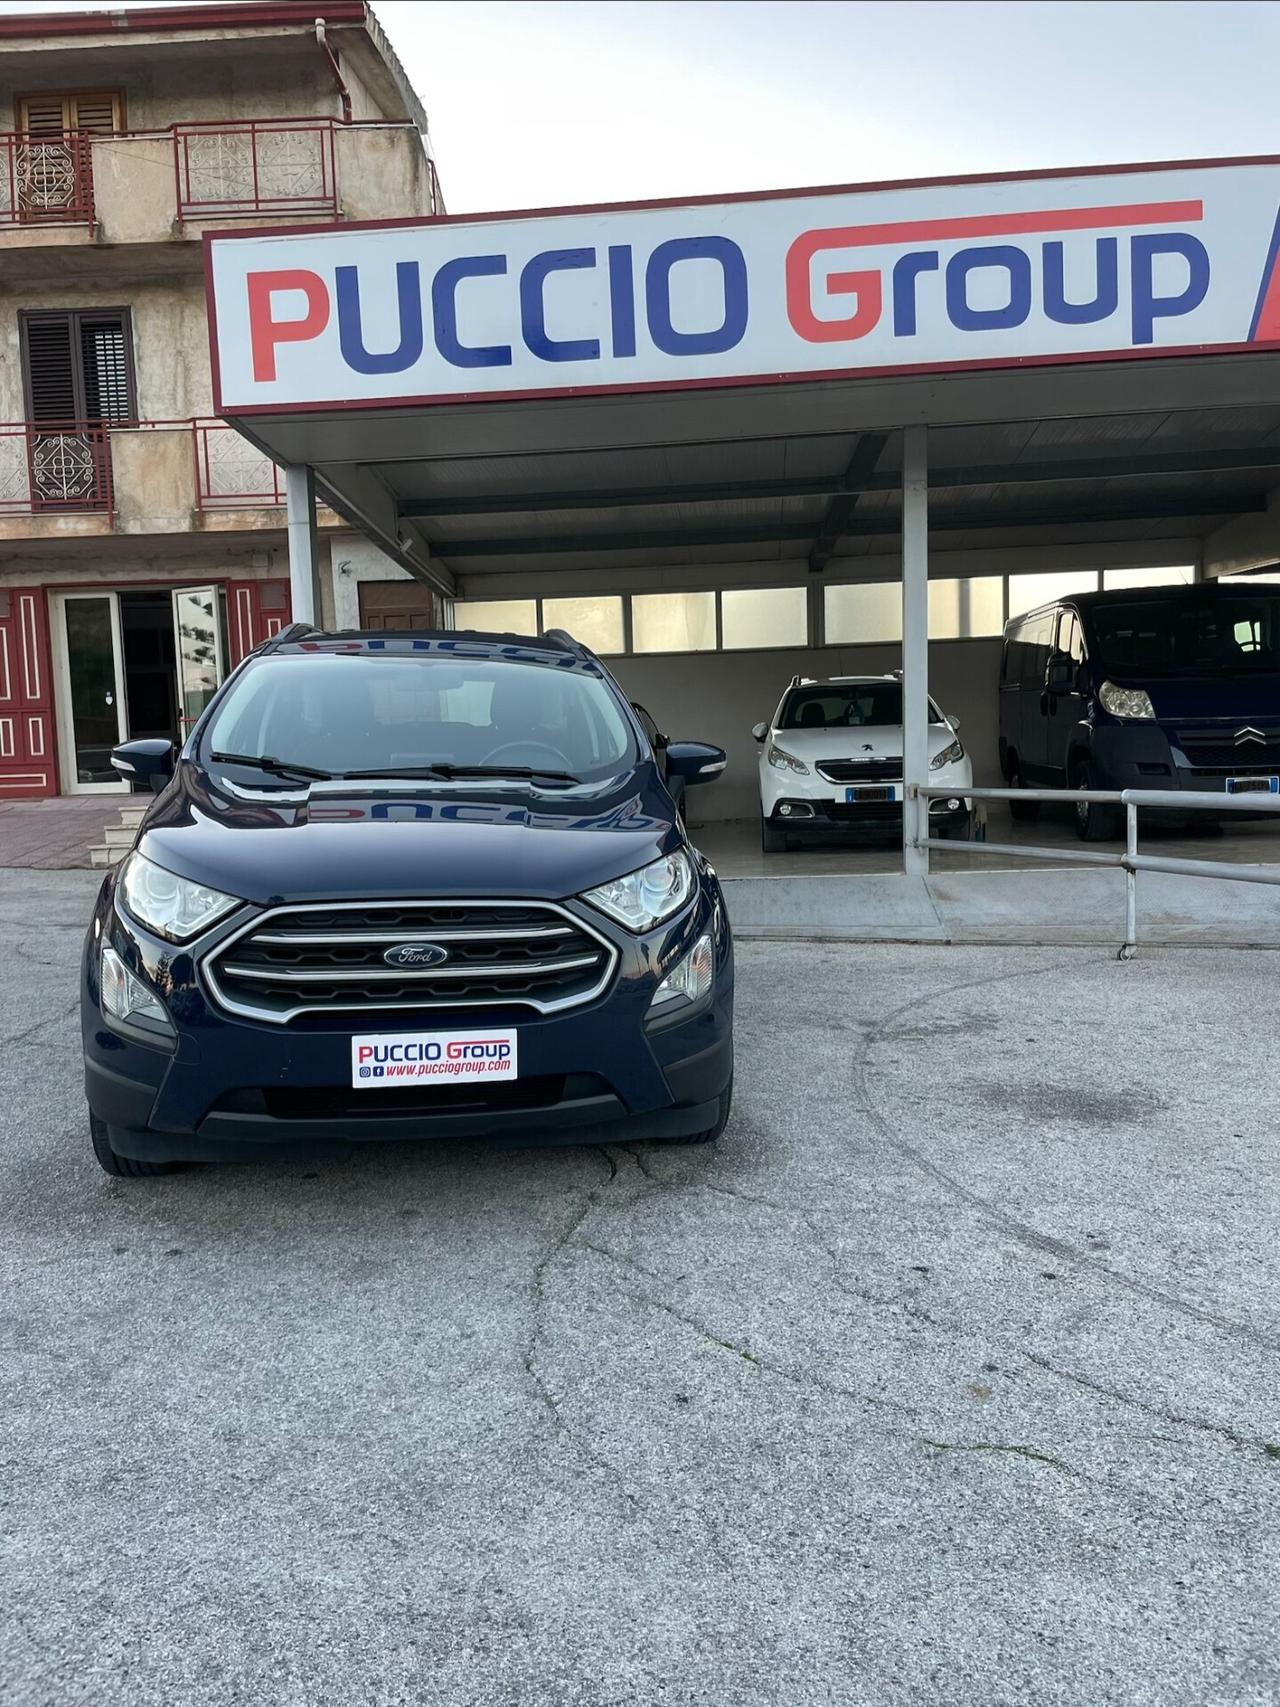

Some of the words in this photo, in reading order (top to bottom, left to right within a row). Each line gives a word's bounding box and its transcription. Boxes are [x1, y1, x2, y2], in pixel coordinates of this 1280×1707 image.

[247, 235, 749, 383] PUCCIO
[786, 199, 1211, 346] Group
[397, 947, 432, 964] Ford
[358, 1042, 442, 1064] PUCCIO
[446, 1039, 511, 1061] Group
[386, 1059, 511, 1078] www.pucciogroup.com
